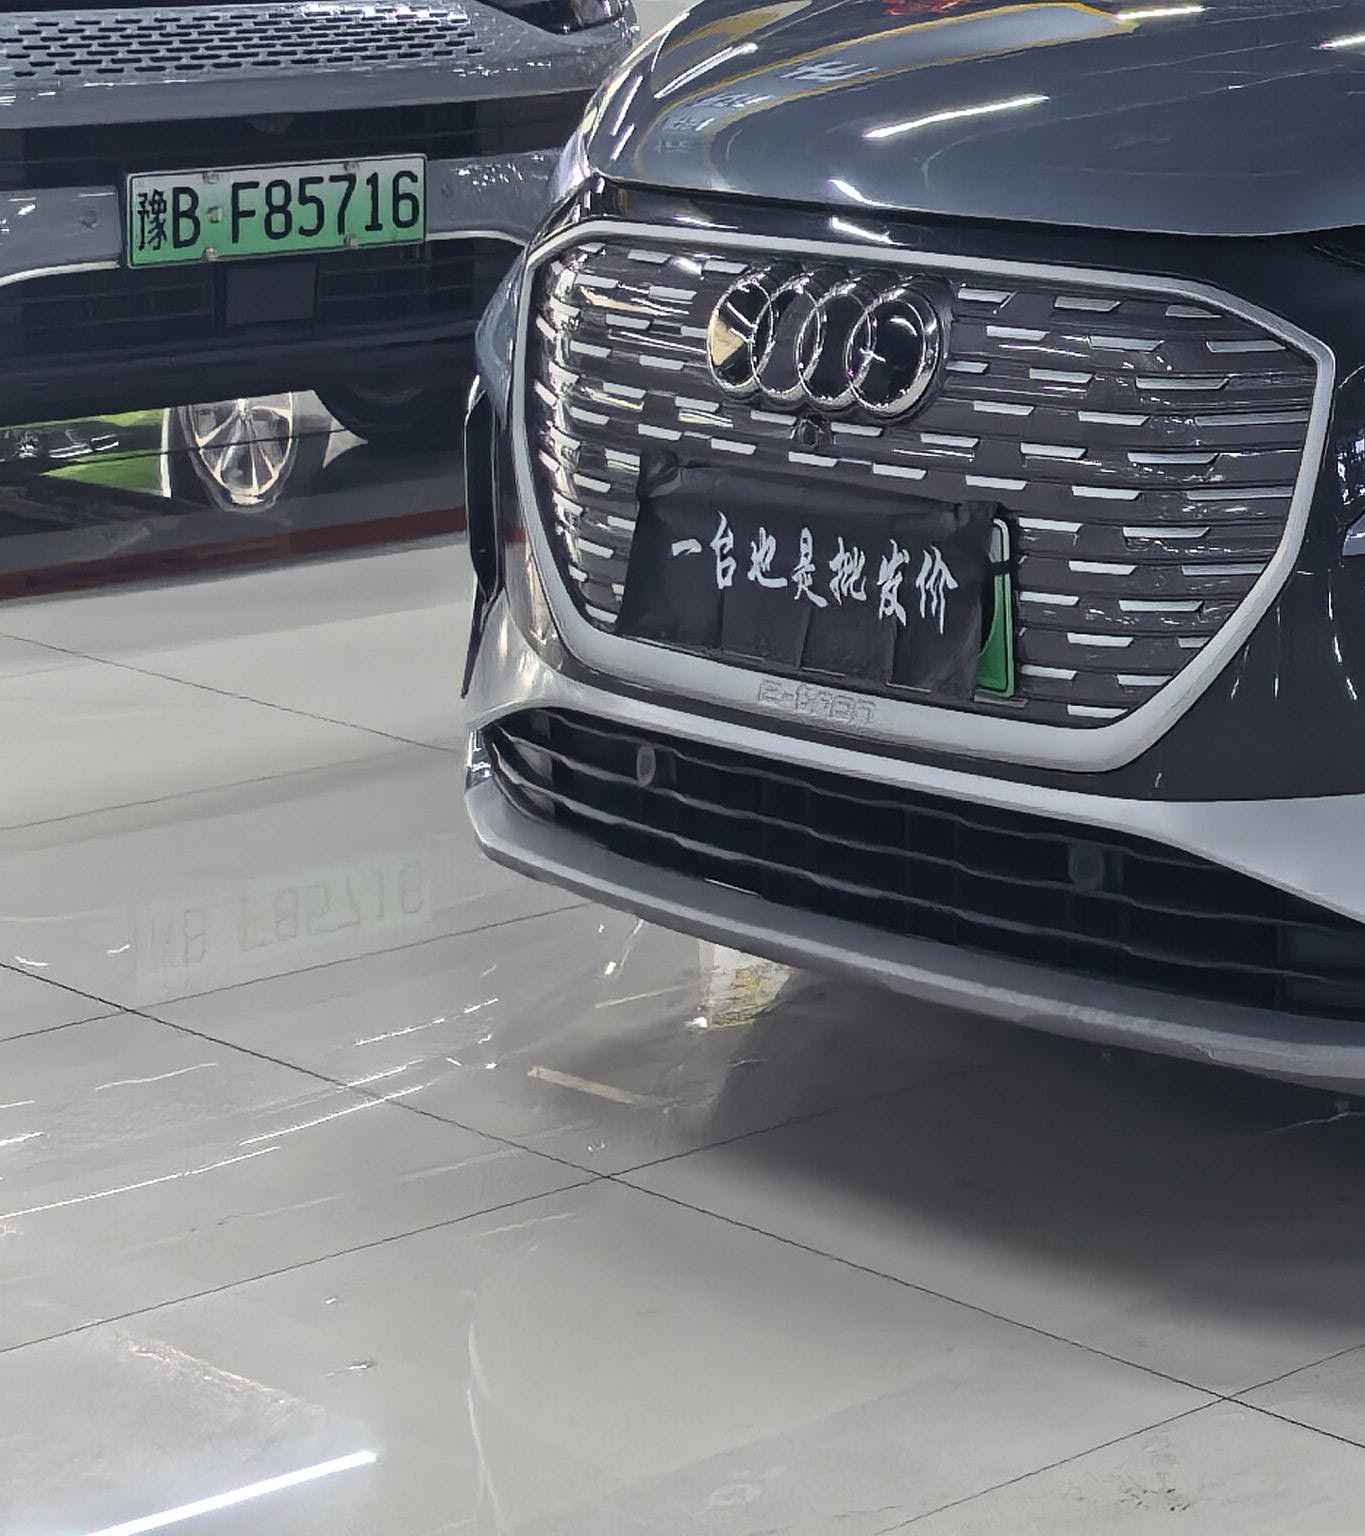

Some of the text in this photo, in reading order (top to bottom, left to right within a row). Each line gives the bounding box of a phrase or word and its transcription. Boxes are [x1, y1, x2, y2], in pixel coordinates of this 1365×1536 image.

[230, 169, 421, 244] F85716
[670, 510, 960, 637] 一台也是批发价
